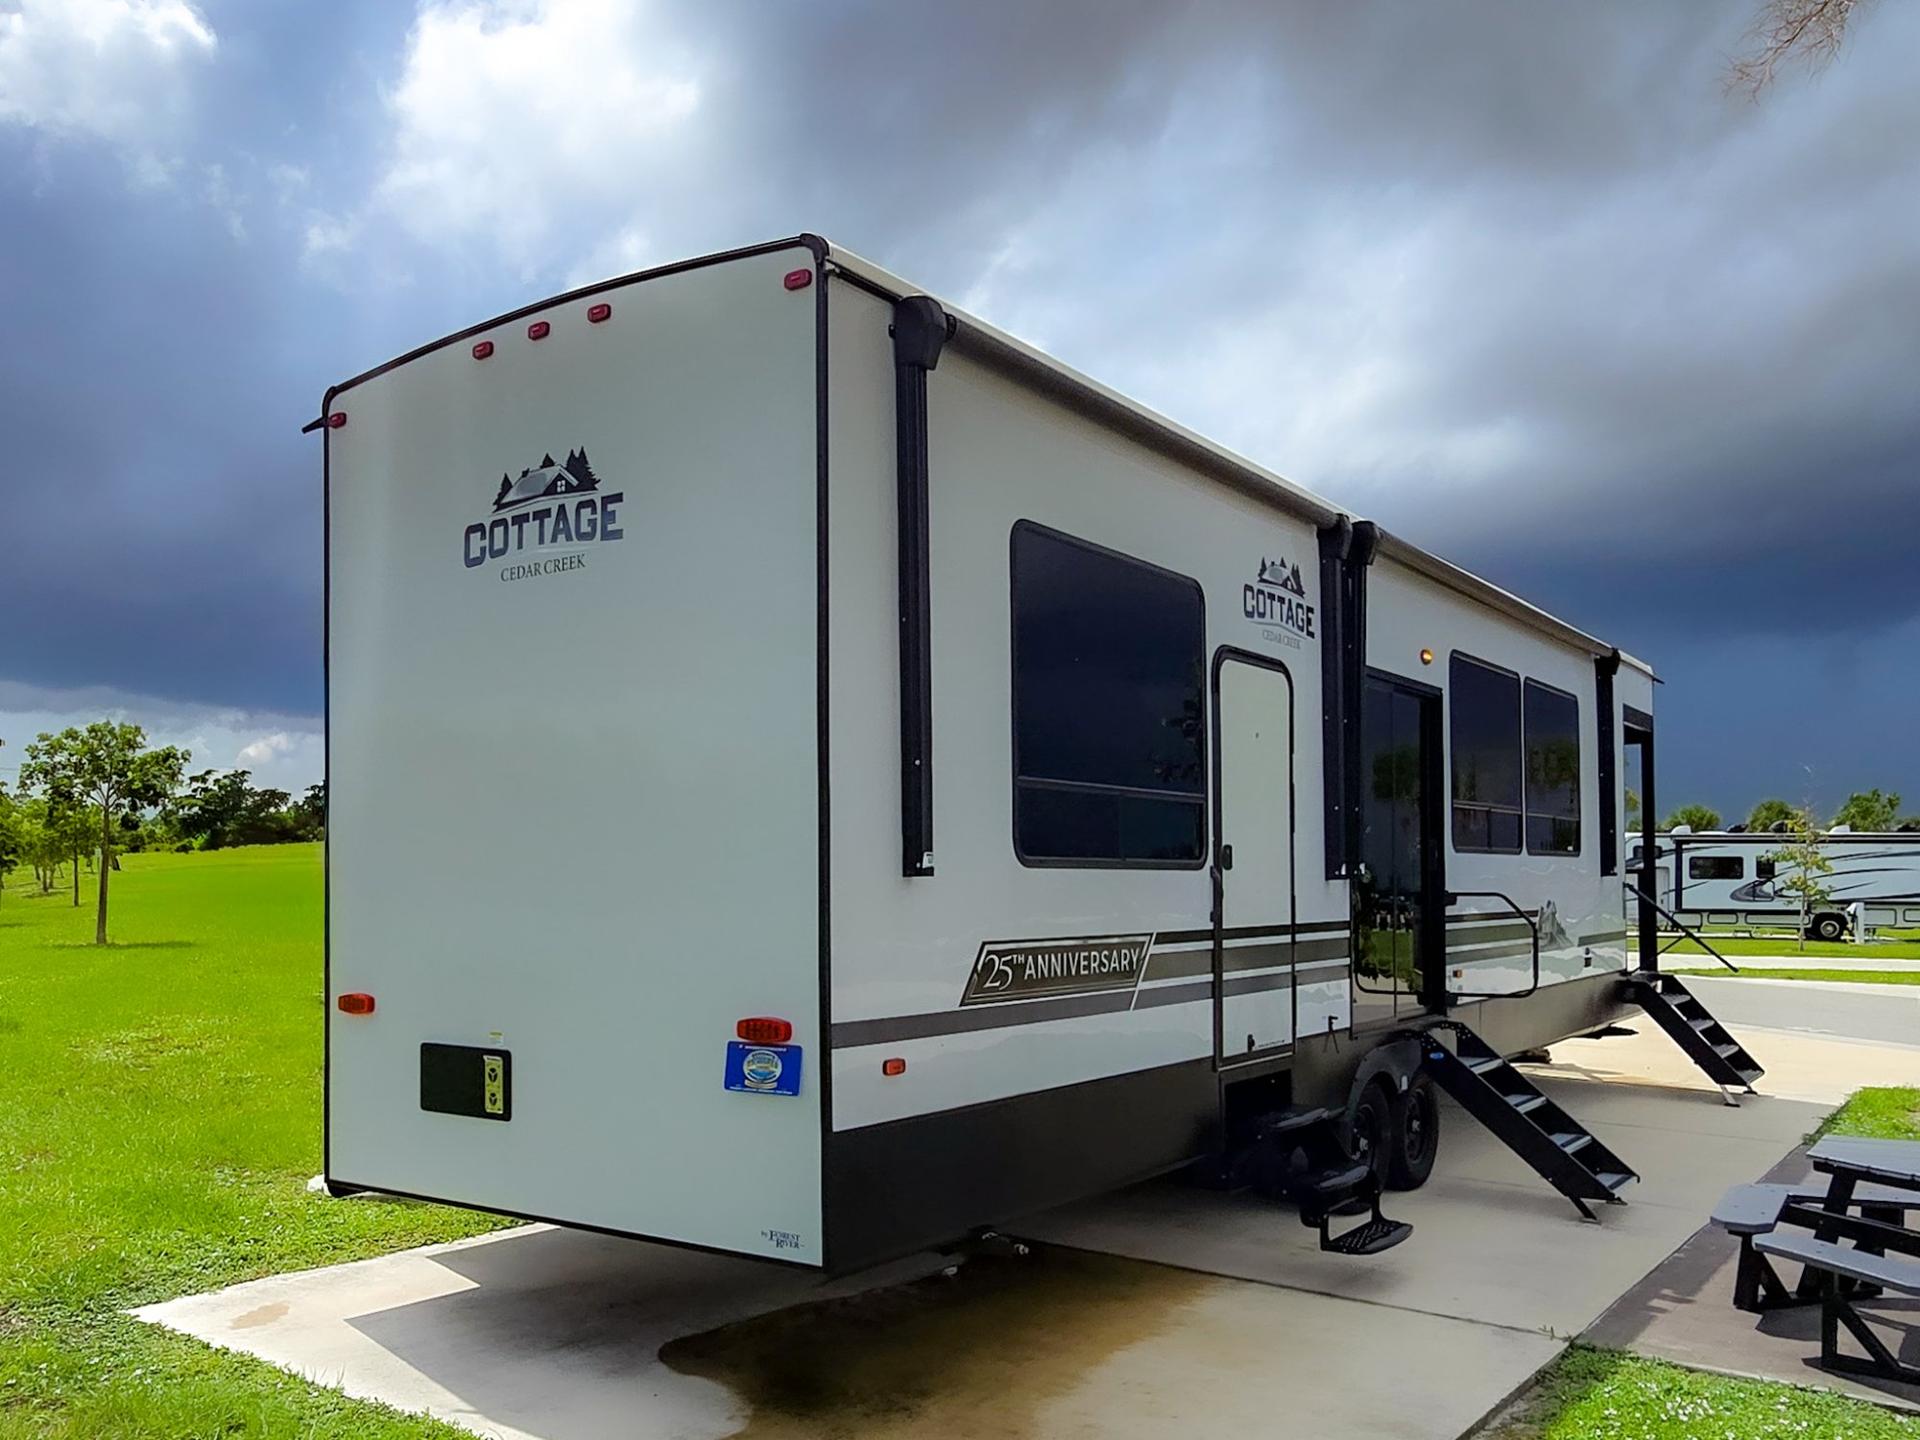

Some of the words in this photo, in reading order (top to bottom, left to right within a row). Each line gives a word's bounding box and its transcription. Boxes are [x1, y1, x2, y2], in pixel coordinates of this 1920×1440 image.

[464, 492, 624, 568] COTTAGE
[500, 561, 542, 582] CEDAR
[543, 553, 586, 575] CREEK
[1243, 583, 1315, 639] COTTAGE
[983, 953, 1025, 991] 25TH
[1024, 948, 1140, 980] ANNIVERSARY
[768, 1230, 801, 1242] FOREST
[775, 1239, 800, 1249] RIVER
